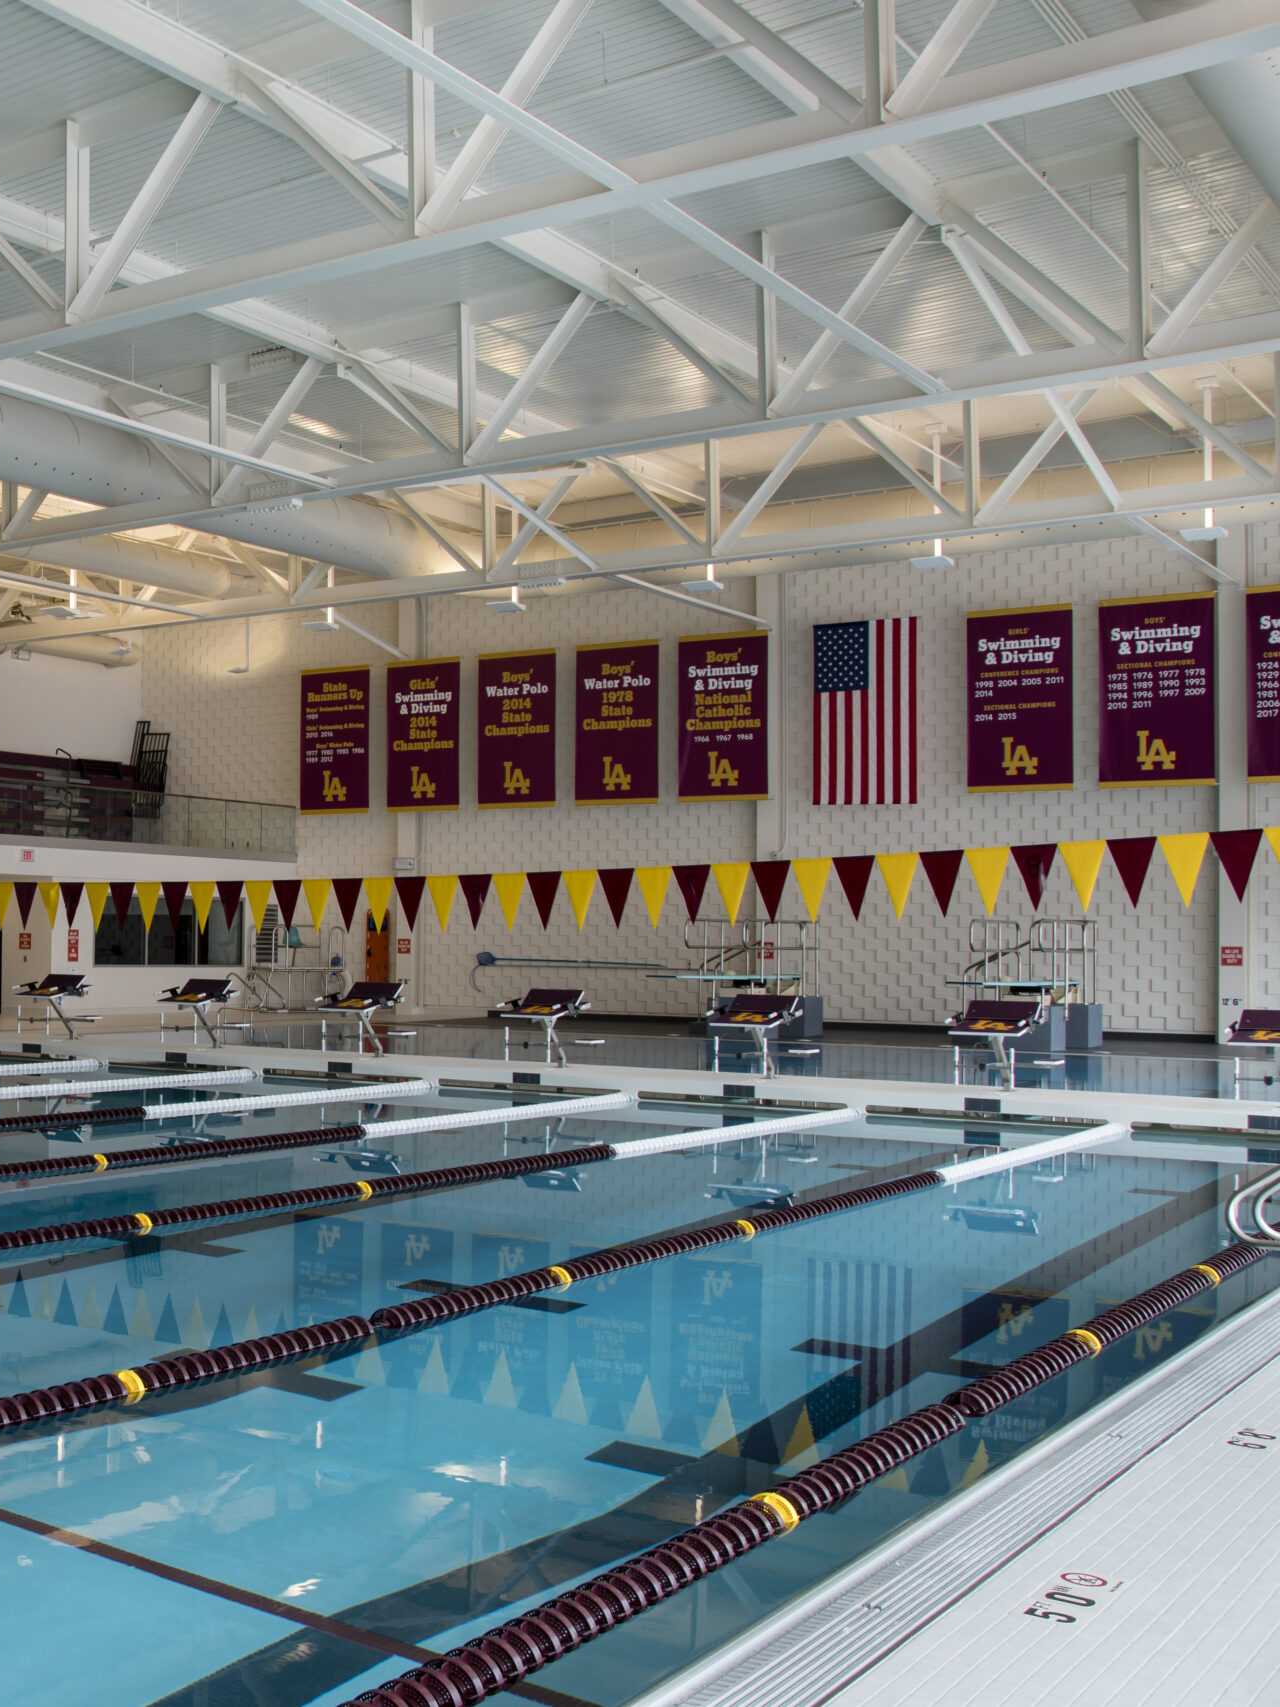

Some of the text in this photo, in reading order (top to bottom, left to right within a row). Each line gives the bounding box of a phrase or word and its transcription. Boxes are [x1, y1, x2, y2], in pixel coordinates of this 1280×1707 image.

[1110, 624, 1201, 641] Swimming
[978, 635, 1061, 651] Swimming
[1118, 639, 1194, 655] & Diving
[706, 648, 742, 664] Boys'
[985, 650, 1054, 665] & Diving
[601, 660, 635, 676] Boys'
[688, 663, 758, 678] Swimming
[1117, 659, 1196, 670] SECTIONAL CHAMPIONS
[1256, 662, 1279, 670] 1924
[502, 668, 533, 684] Boys'
[980, 668, 1059, 678] CONFERENCE CHAMPIONS
[1107, 668, 1206, 681] 1975 1976 1977 1978
[1257, 671, 1280, 680] 1929
[323, 682, 347, 692] State
[409, 676, 438, 690] Girls'
[584, 675, 651, 690] Water Polo
[694, 678, 753, 691] & Diving
[975, 676, 1064, 689] 1998 2004 2005 2011
[1132, 681, 1153, 689] 1989
[1158, 680, 1179, 688] 1990
[1184, 678, 1206, 686] 1993
[1257, 681, 1280, 689] 1966
[307, 689, 363, 702] Runners Up
[395, 690, 452, 703] Swimming
[485, 683, 548, 697] Water Polo
[974, 690, 993, 698] 2014
[1107, 688, 1206, 700] 1994 1996 1997 2009
[1257, 690, 1278, 699] 1981
[502, 698, 532, 710] 2014
[602, 691, 634, 704] 1978
[695, 691, 752, 706] National
[399, 703, 447, 715] & Diving
[601, 705, 633, 717] State
[696, 704, 751, 718] Catholic
[1018, 701, 1056, 709] CHAMPIONS
[1107, 700, 1152, 710] 2010 2011
[502, 712, 532, 723] State
[974, 714, 993, 722] 2014
[1256, 709, 1278, 718] 2017
[409, 716, 437, 728] 2014
[583, 717, 652, 731] Champions
[686, 717, 761, 732] Champions
[409, 728, 437, 739] State
[484, 723, 550, 737] Champions
[393, 739, 454, 751] Champions
[1136, 730, 1176, 770] LA
[1002, 737, 1038, 775] LA
[602, 756, 631, 791] LA
[708, 751, 739, 787] LA
[410, 766, 436, 798] LA
[503, 761, 530, 795] LA
[323, 770, 346, 801] LA
[1023, 1607, 1076, 1623] 5
